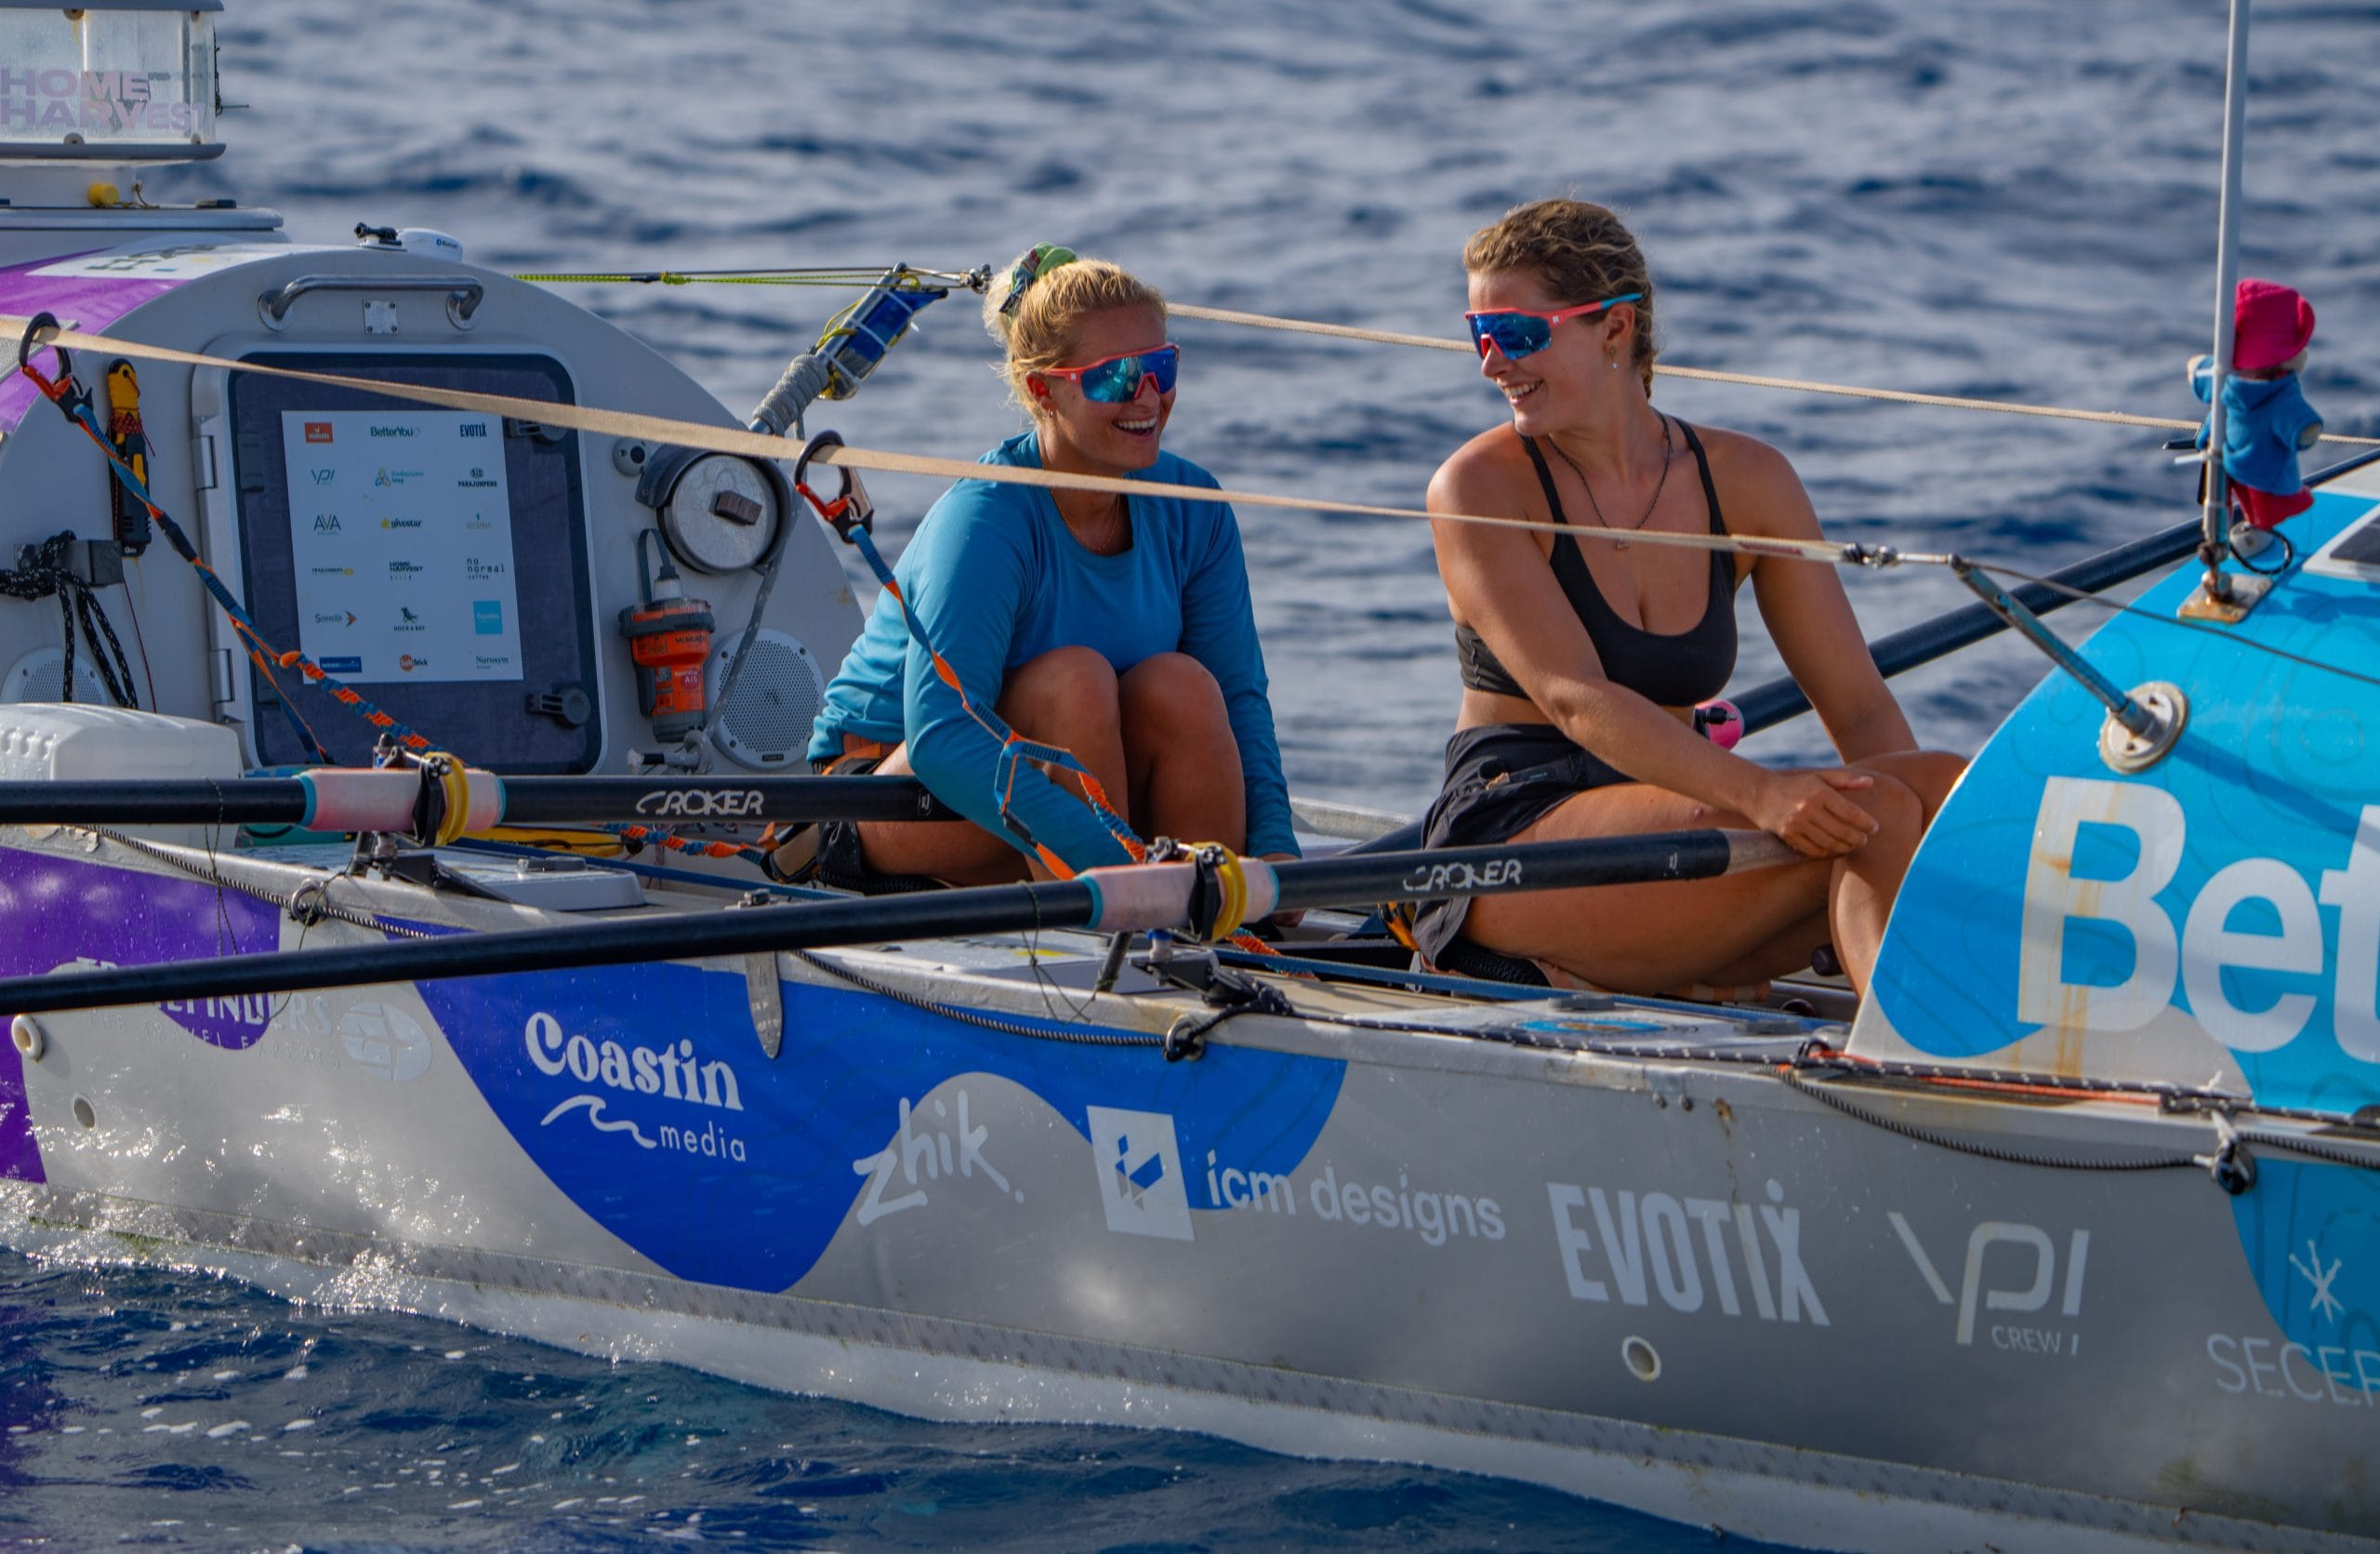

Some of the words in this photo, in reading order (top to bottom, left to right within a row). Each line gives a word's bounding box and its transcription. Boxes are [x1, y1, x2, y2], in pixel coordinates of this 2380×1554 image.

[0, 67, 150, 102] HOME
[0, 99, 206, 130] HARVEST
[370, 425, 414, 437] BetterYou
[313, 514, 341, 531] AVA
[390, 518, 422, 530] givestar
[467, 564, 505, 574] normal
[475, 656, 509, 666] Nurosym
[635, 789, 764, 816] CROKER
[524, 1011, 744, 1111] Coastin
[659, 1121, 747, 1162] media
[1207, 1150, 1297, 1215] icm
[1309, 1166, 1506, 1245] designs
[1546, 1178, 1831, 1327] EVOTIX
[1990, 1324, 2062, 1354] CREW
